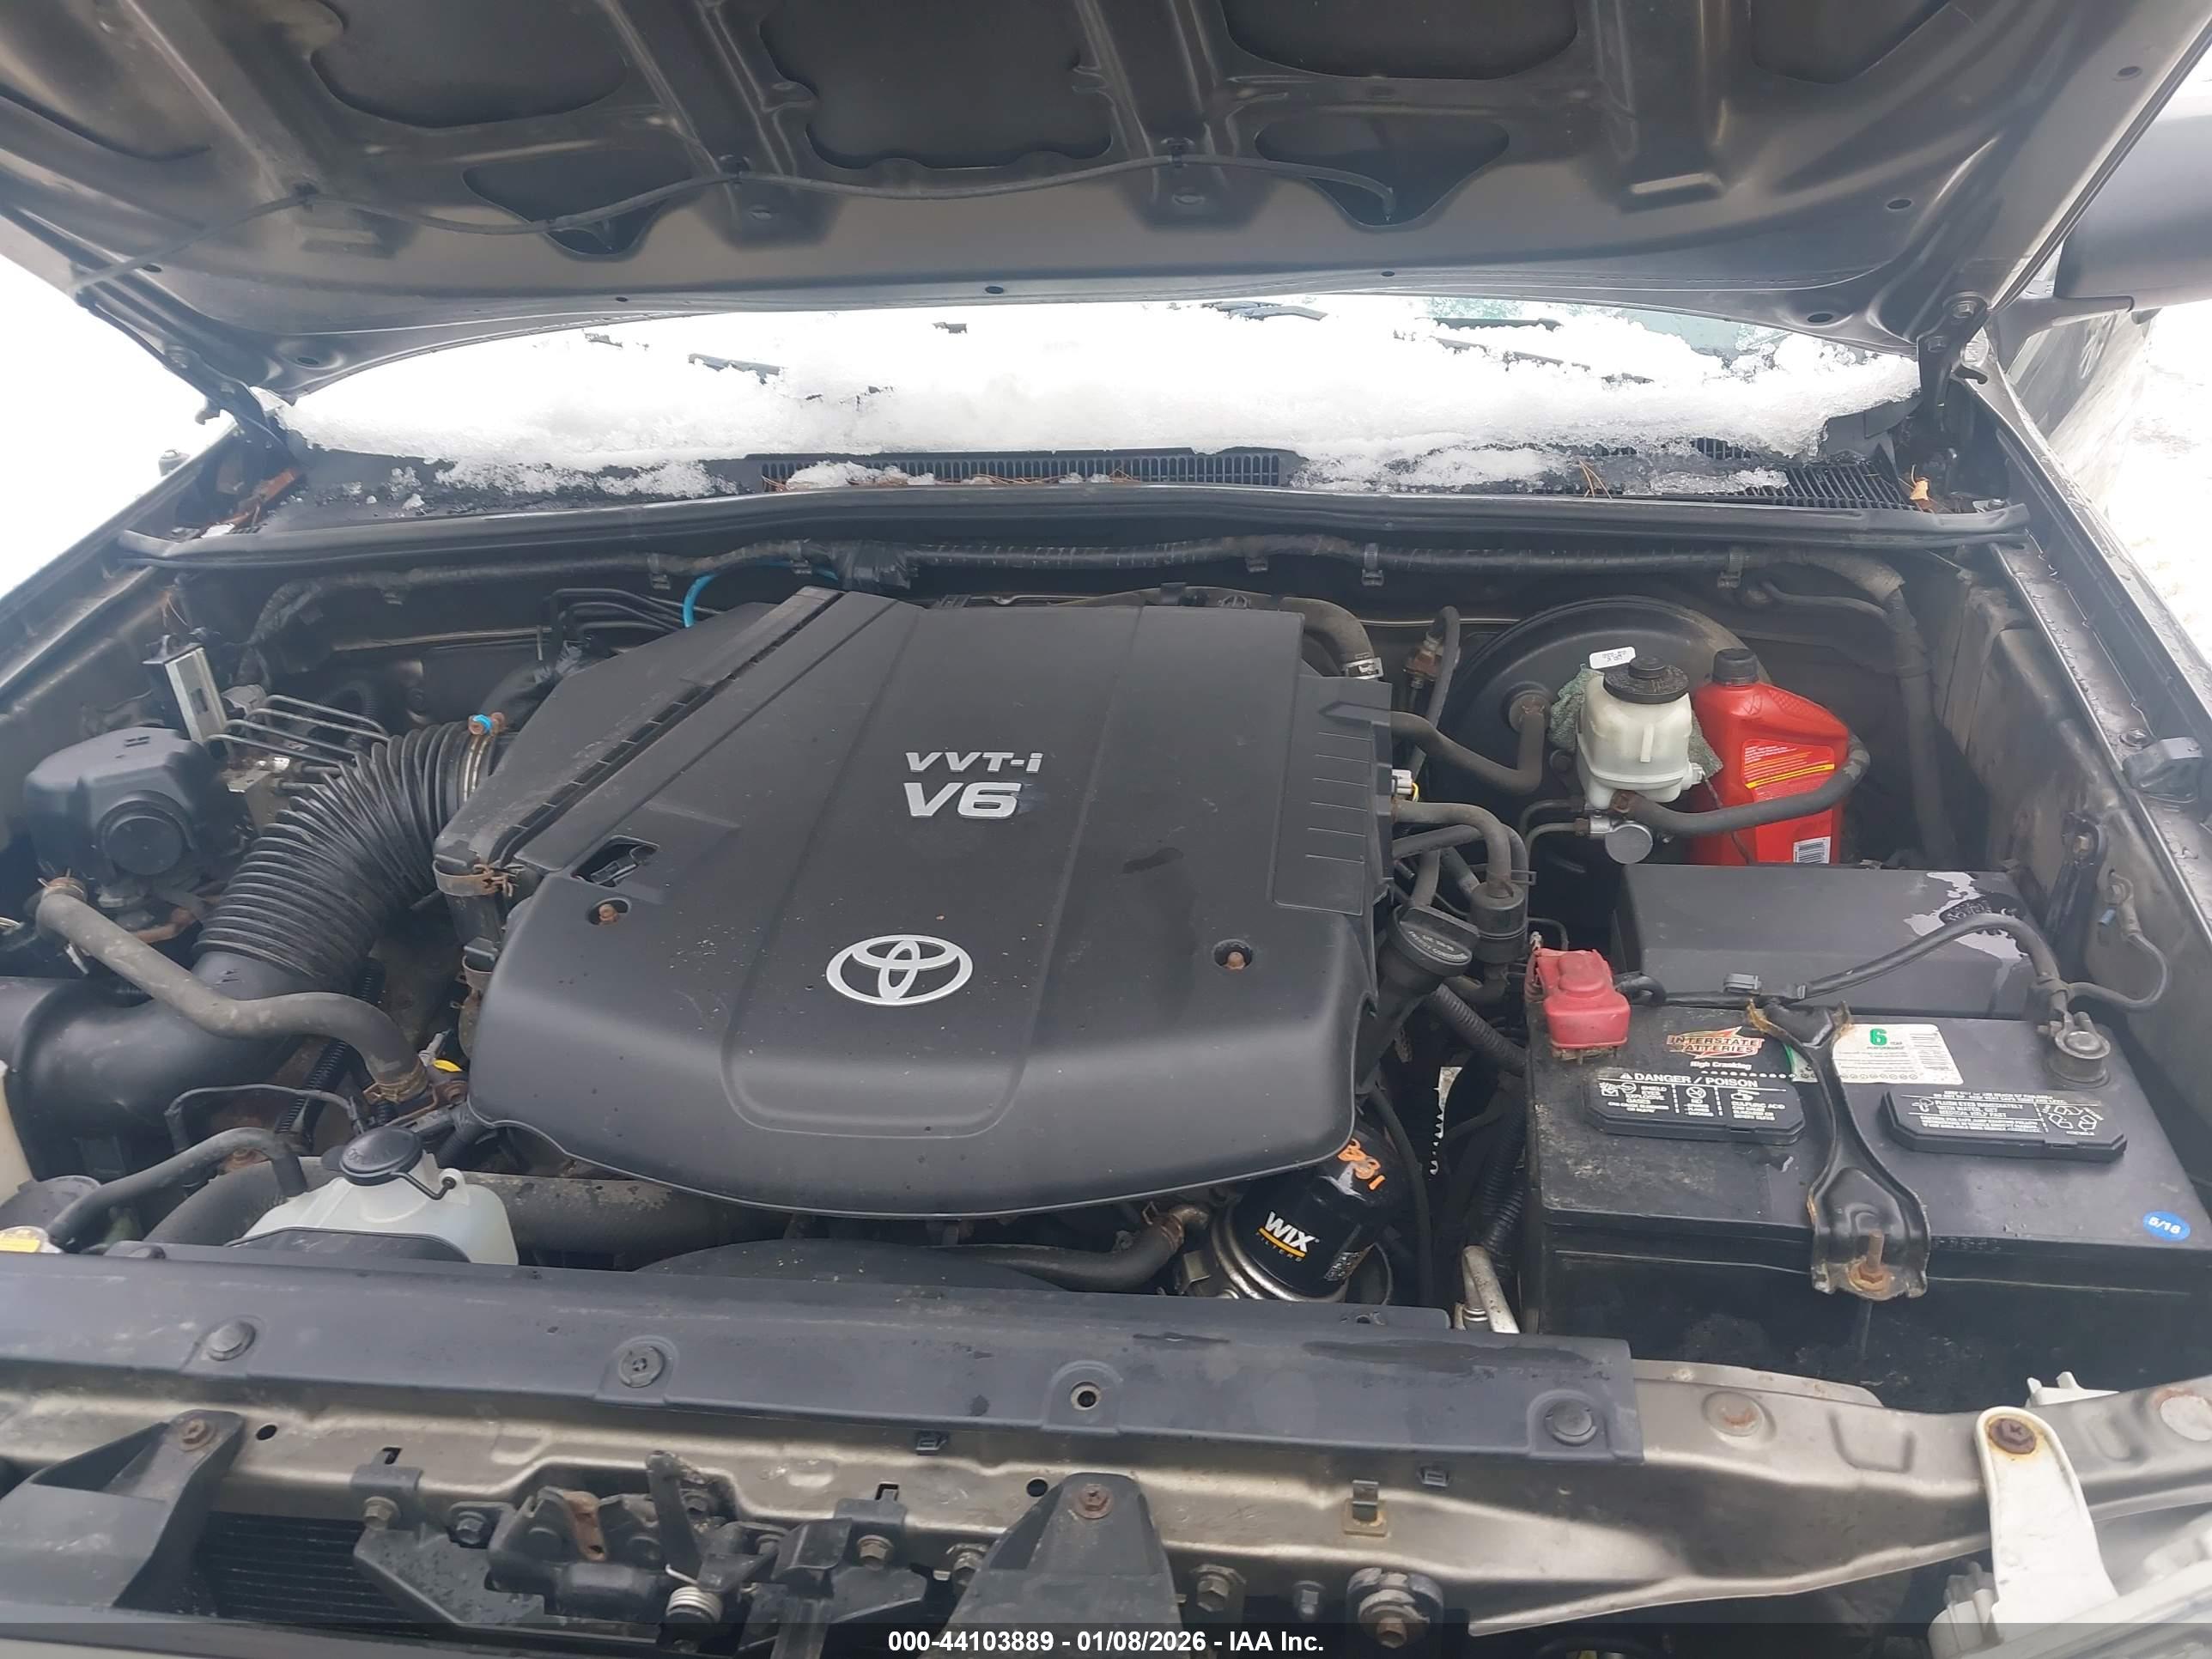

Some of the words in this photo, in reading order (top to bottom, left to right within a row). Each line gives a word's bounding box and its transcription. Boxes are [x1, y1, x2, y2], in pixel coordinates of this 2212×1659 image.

[905, 751, 1043, 772] VVT-i
[903, 782, 1022, 817] V6
[1671, 1036, 1759, 1047] INTERSTATE
[1870, 1028, 1887, 1045] 6
[1634, 1073, 1692, 1084] DANGER
[1705, 1077, 1758, 1088] POISON
[1264, 1211, 1316, 1253] WIX
